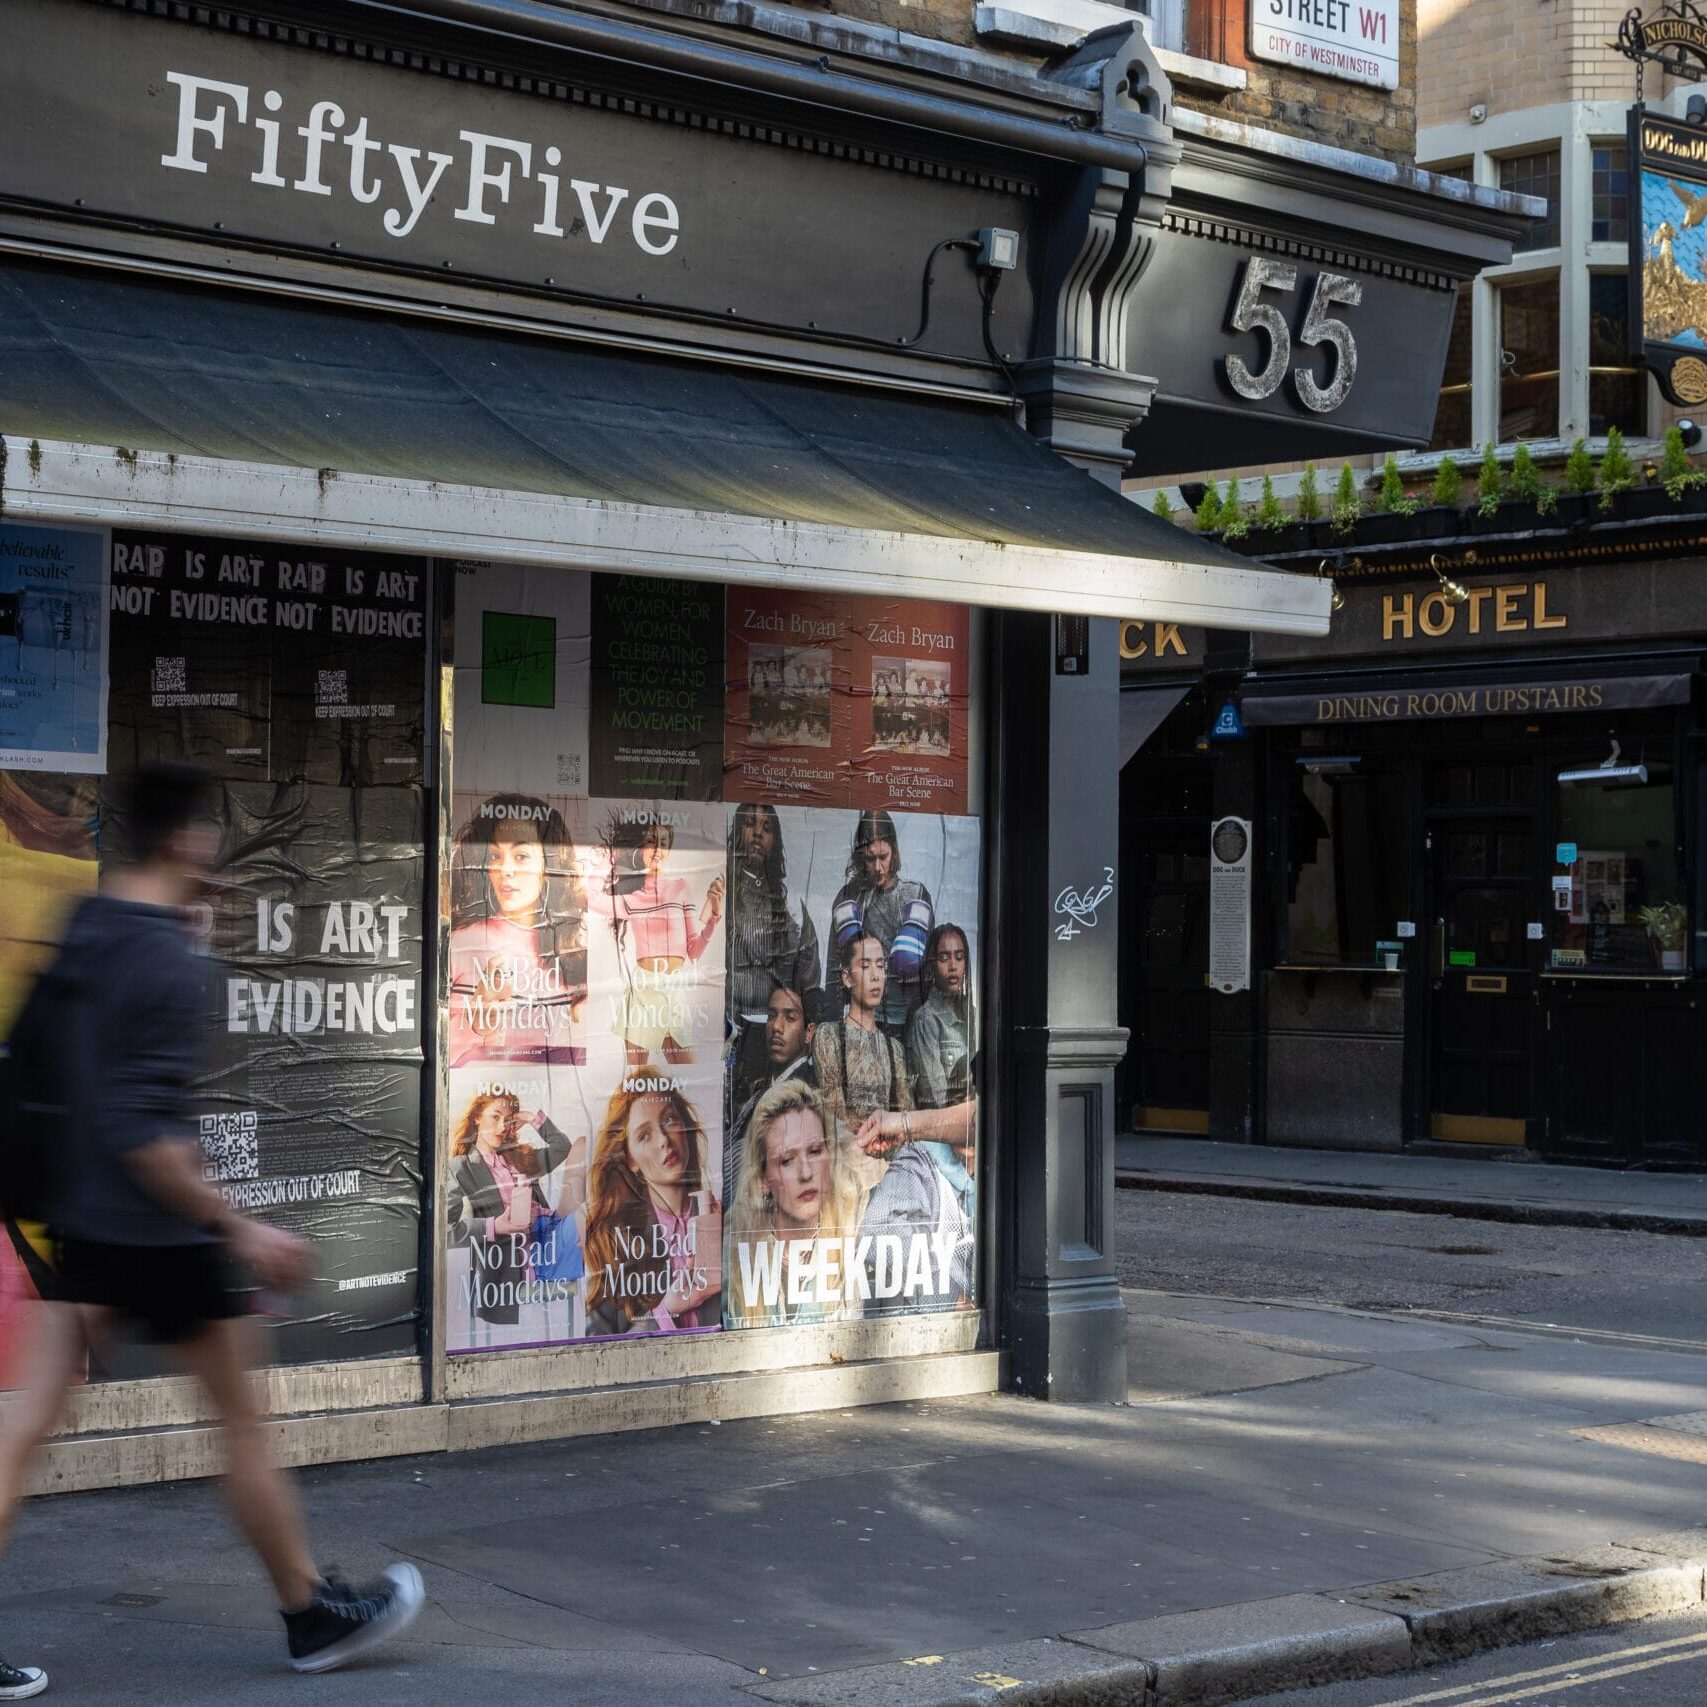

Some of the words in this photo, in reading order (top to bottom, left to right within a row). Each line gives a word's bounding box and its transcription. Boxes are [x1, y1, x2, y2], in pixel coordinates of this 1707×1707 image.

[1359, 7, 1386, 45] W1
[1269, 35, 1291, 54] CITY
[1295, 42, 1307, 58] OF
[1310, 45, 1379, 78] WESTMINSTER
[1645, 129, 1673, 154] DOG
[161, 71, 681, 255] FiftyFive
[1225, 255, 1363, 413] 55
[113, 542, 165, 578] RAP
[185, 549, 206, 579] IS
[218, 553, 265, 587] ART
[455, 567, 477, 576] NOW
[278, 561, 327, 594] RAP
[345, 567, 365, 595] IS
[376, 570, 419, 601] ART
[617, 576, 630, 590] A
[631, 577, 677, 593] GUIDE
[681, 581, 700, 596] BY
[111, 585, 155, 616] NOT
[170, 589, 268, 625] EVIDENCE
[275, 601, 317, 631] NOT
[331, 605, 423, 638] EVIDENCE
[606, 593, 678, 621] WOMEN,
[680, 601, 711, 621] FOR
[1382, 582, 1568, 641] HOTEL
[622, 619, 694, 645] WOMEN,
[743, 608, 784, 632] Zach
[790, 613, 837, 640] Bryan
[867, 623, 905, 645] Zach
[911, 627, 955, 653] Bryan
[1120, 619, 1188, 659] CK
[608, 640, 708, 665] CELEBRATING
[608, 663, 639, 682] THE
[638, 665, 668, 684] JOY
[671, 669, 707, 688] AND
[151, 693, 166, 707] KEEP
[166, 693, 200, 706] EXPRESSION
[200, 693, 211, 706] OUT
[211, 693, 220, 706] OF
[219, 693, 238, 706] COURT
[314, 705, 329, 718] KEEP
[329, 705, 361, 718] EXPRESSION
[360, 705, 370, 717] OUT
[370, 704, 378, 717] OF
[378, 704, 395, 717] COURT
[618, 687, 674, 708] POWER
[676, 690, 699, 710] OF
[1317, 694, 1400, 722] DINING
[1407, 691, 1477, 715] ROOM
[1485, 684, 1603, 712] UPSTAIRS
[612, 710, 705, 733] MOVEMENT
[1215, 726, 1238, 734] Chubb
[646, 748, 662, 756] MOVE
[742, 762, 759, 775] The
[762, 763, 788, 777] Great
[790, 766, 835, 780] American
[766, 777, 782, 788] Bar
[784, 778, 811, 790] Scene
[866, 771, 883, 784] The
[885, 772, 910, 785] Great
[912, 774, 954, 788] American
[888, 785, 904, 797] Bar
[906, 786, 932, 799] Scene
[480, 804, 553, 822] MONDAY
[623, 810, 691, 827] MONDAY
[257, 899, 295, 953] IS
[320, 901, 408, 958] ART
[472, 957, 509, 993] No
[512, 957, 561, 992] Bad
[652, 957, 699, 992] Bad
[227, 977, 416, 1035] EVIDENCE
[458, 995, 572, 1037] Mondays
[607, 992, 709, 1035] Mondays
[478, 1080, 550, 1097] MONDAY
[622, 1077, 688, 1093] MONDAY
[222, 1180, 286, 1210] EXPRESSION
[287, 1177, 309, 1201] OUT
[311, 1177, 325, 1199] OF
[326, 1170, 361, 1197] COURT
[470, 1235, 503, 1271] No
[510, 1230, 557, 1269] Bad
[614, 1225, 646, 1261] No
[651, 1220, 698, 1258] Bad
[338, 1271, 407, 1291] @ARTNOTEVIDENCE
[602, 1261, 708, 1301] Mondays
[738, 1232, 960, 1308] WEEKDAY
[458, 1270, 568, 1312] Mondays
